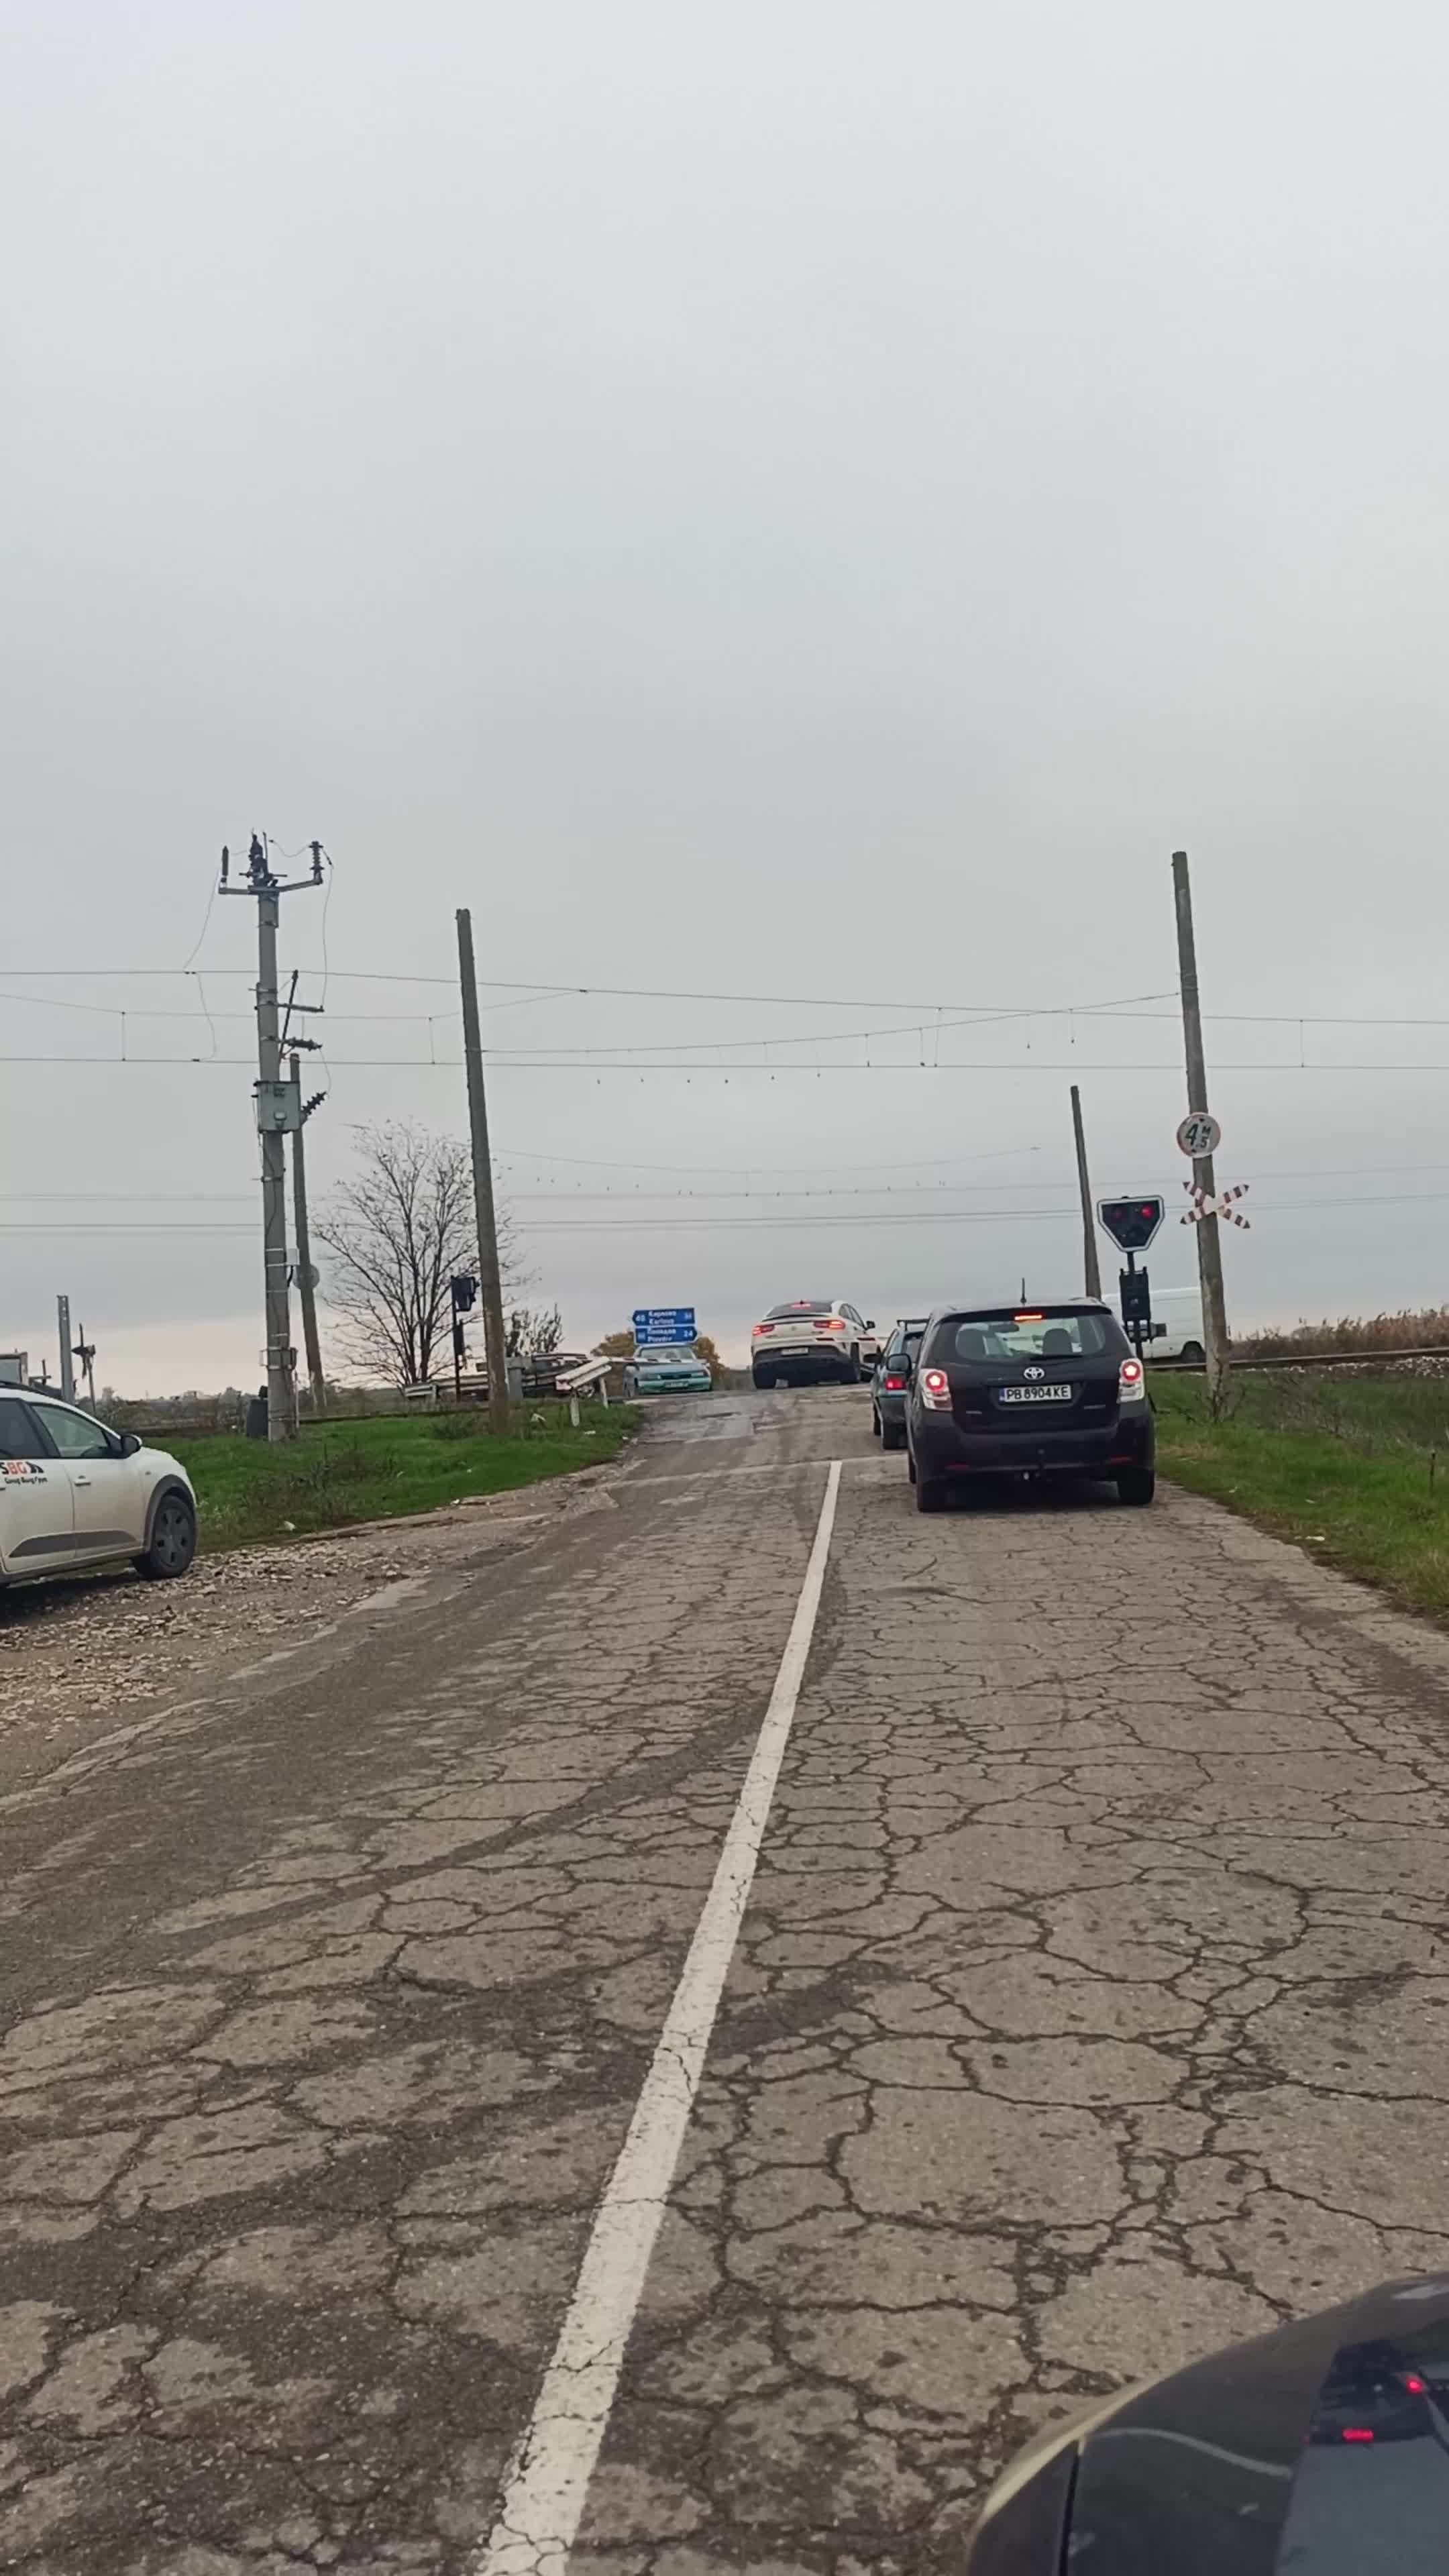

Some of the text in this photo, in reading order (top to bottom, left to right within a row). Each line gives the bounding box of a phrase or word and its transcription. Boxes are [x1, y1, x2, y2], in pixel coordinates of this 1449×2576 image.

[1007, 1386, 1069, 1400] PB 8904 KE
